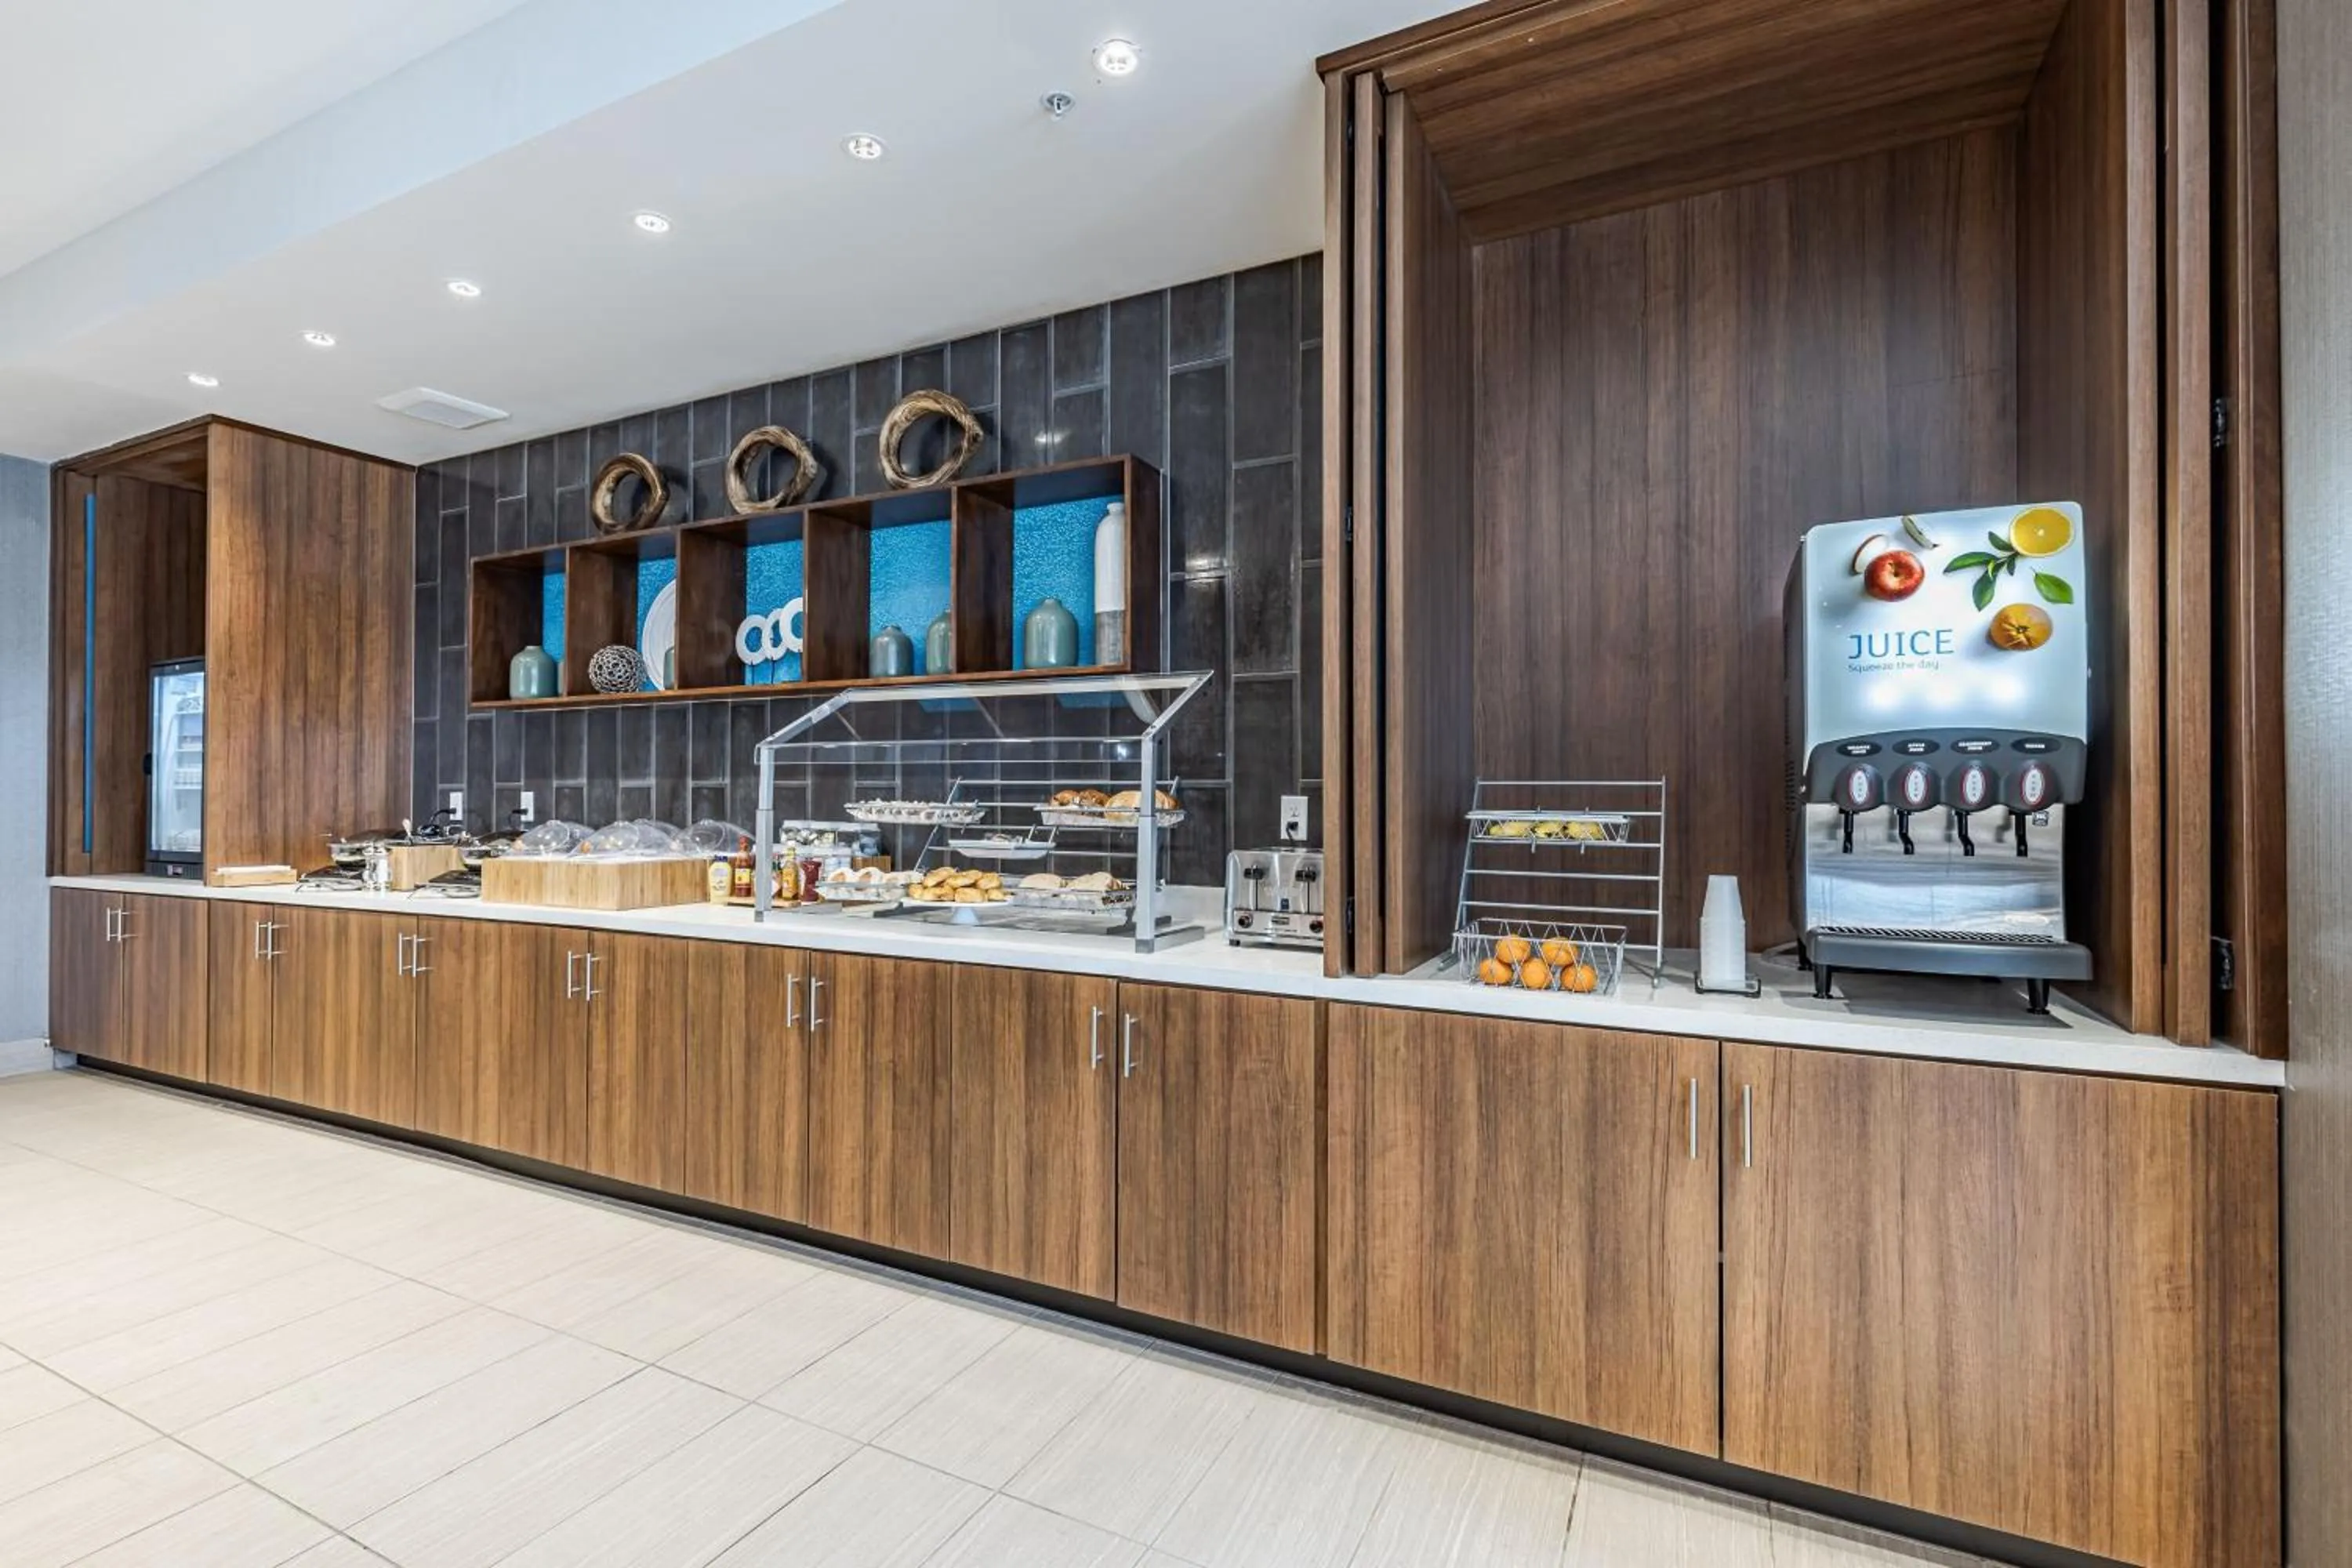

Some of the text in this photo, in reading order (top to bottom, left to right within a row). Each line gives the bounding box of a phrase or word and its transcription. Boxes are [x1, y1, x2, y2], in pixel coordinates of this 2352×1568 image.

[1848, 629, 1955, 659] JUICE
[1896, 661, 1915, 670] the
[1918, 659, 1940, 670] day
